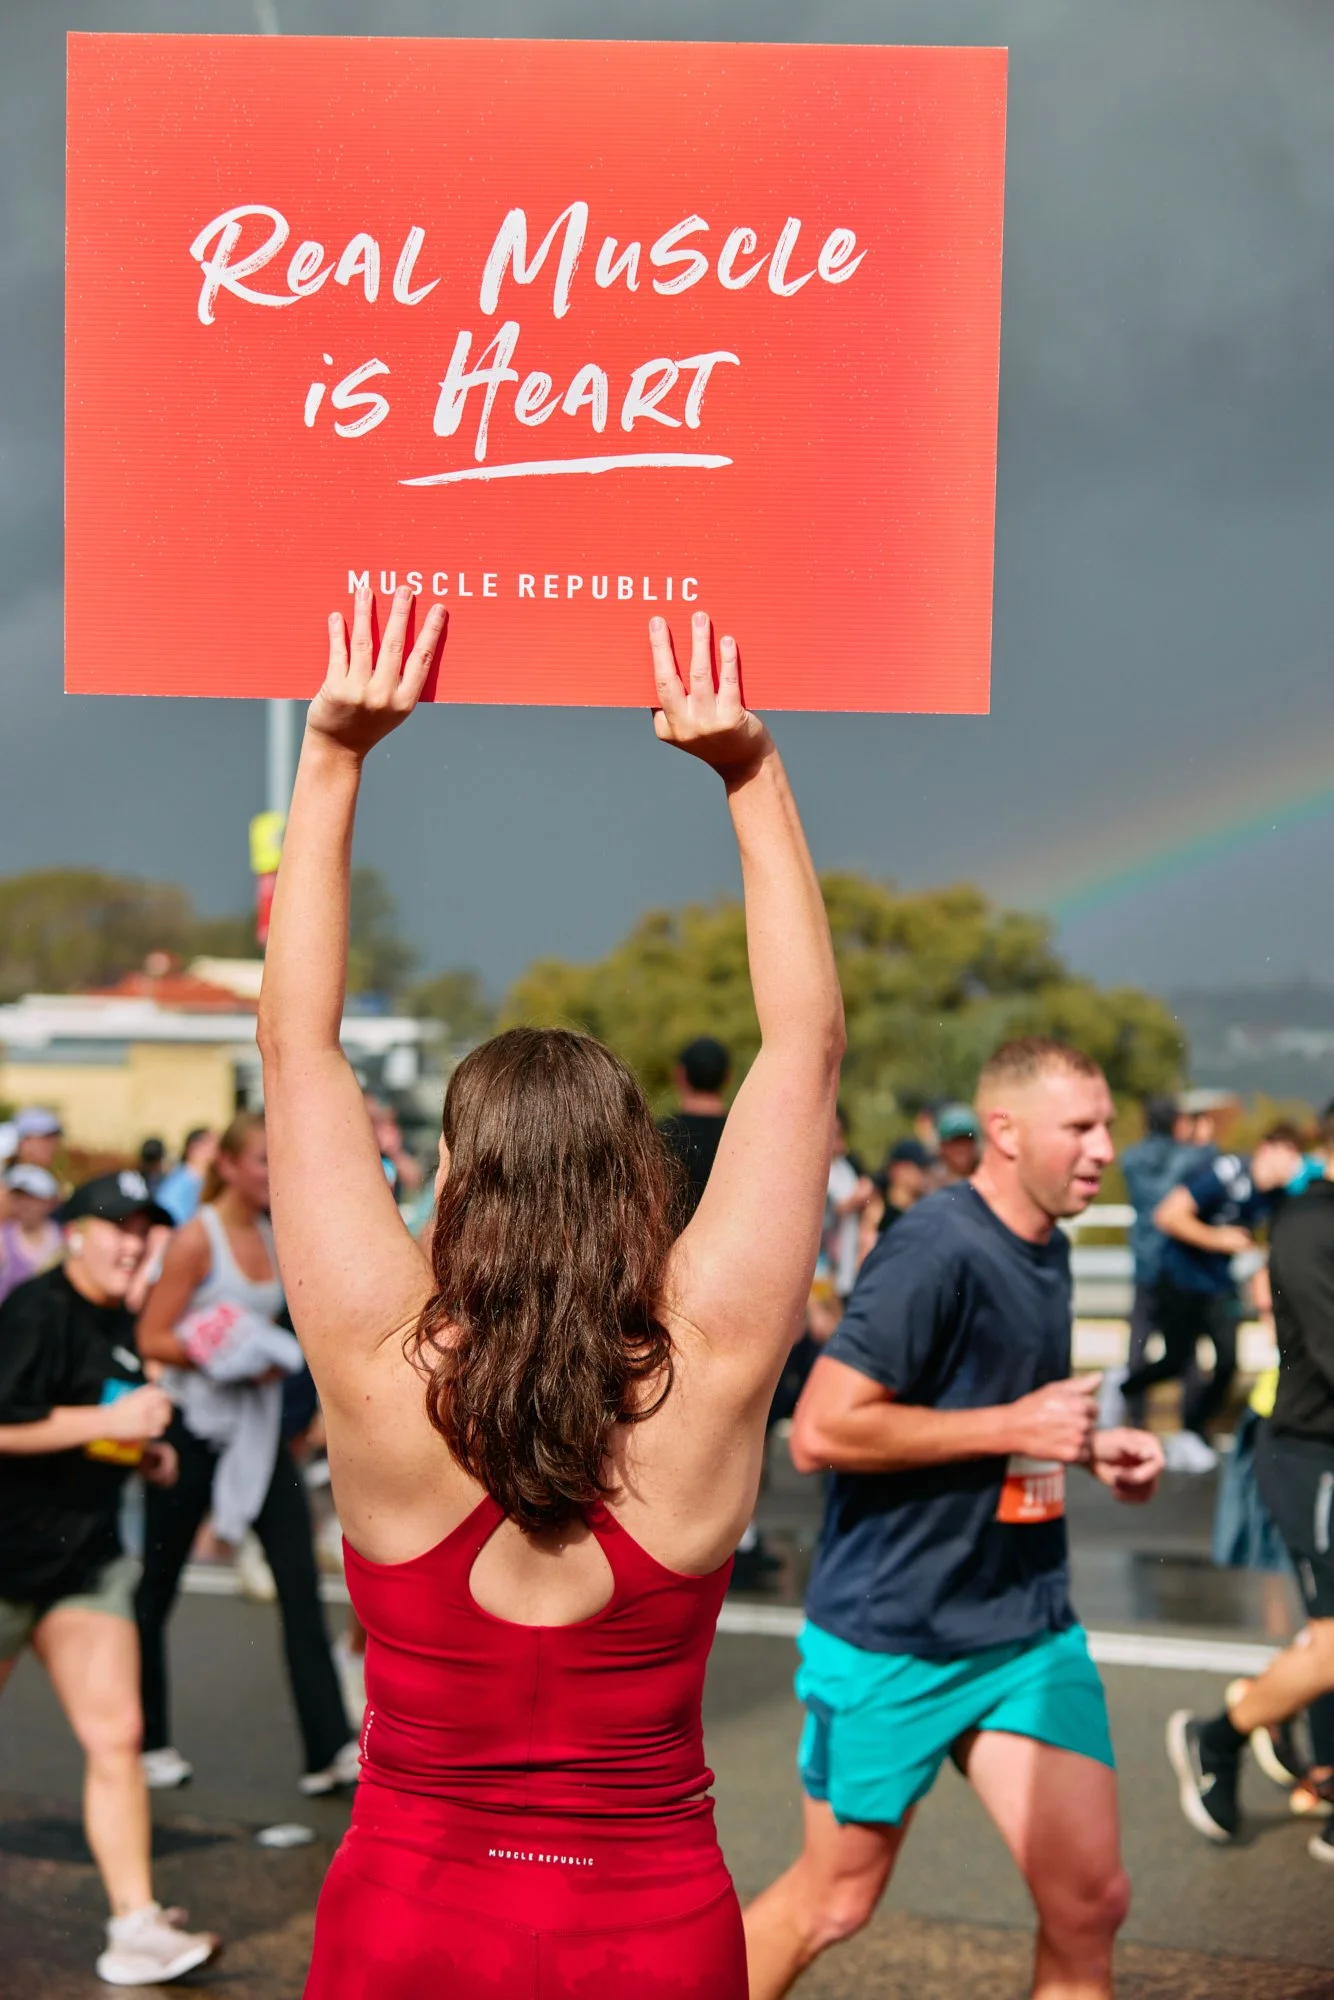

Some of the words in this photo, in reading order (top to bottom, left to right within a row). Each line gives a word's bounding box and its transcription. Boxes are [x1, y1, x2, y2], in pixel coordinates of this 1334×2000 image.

[348, 569, 498, 598] MUSCLE
[518, 573, 700, 602] REPUBLIC
[488, 1848, 534, 1861] MUSCLE
[538, 1853, 594, 1866] REPUBLIC
